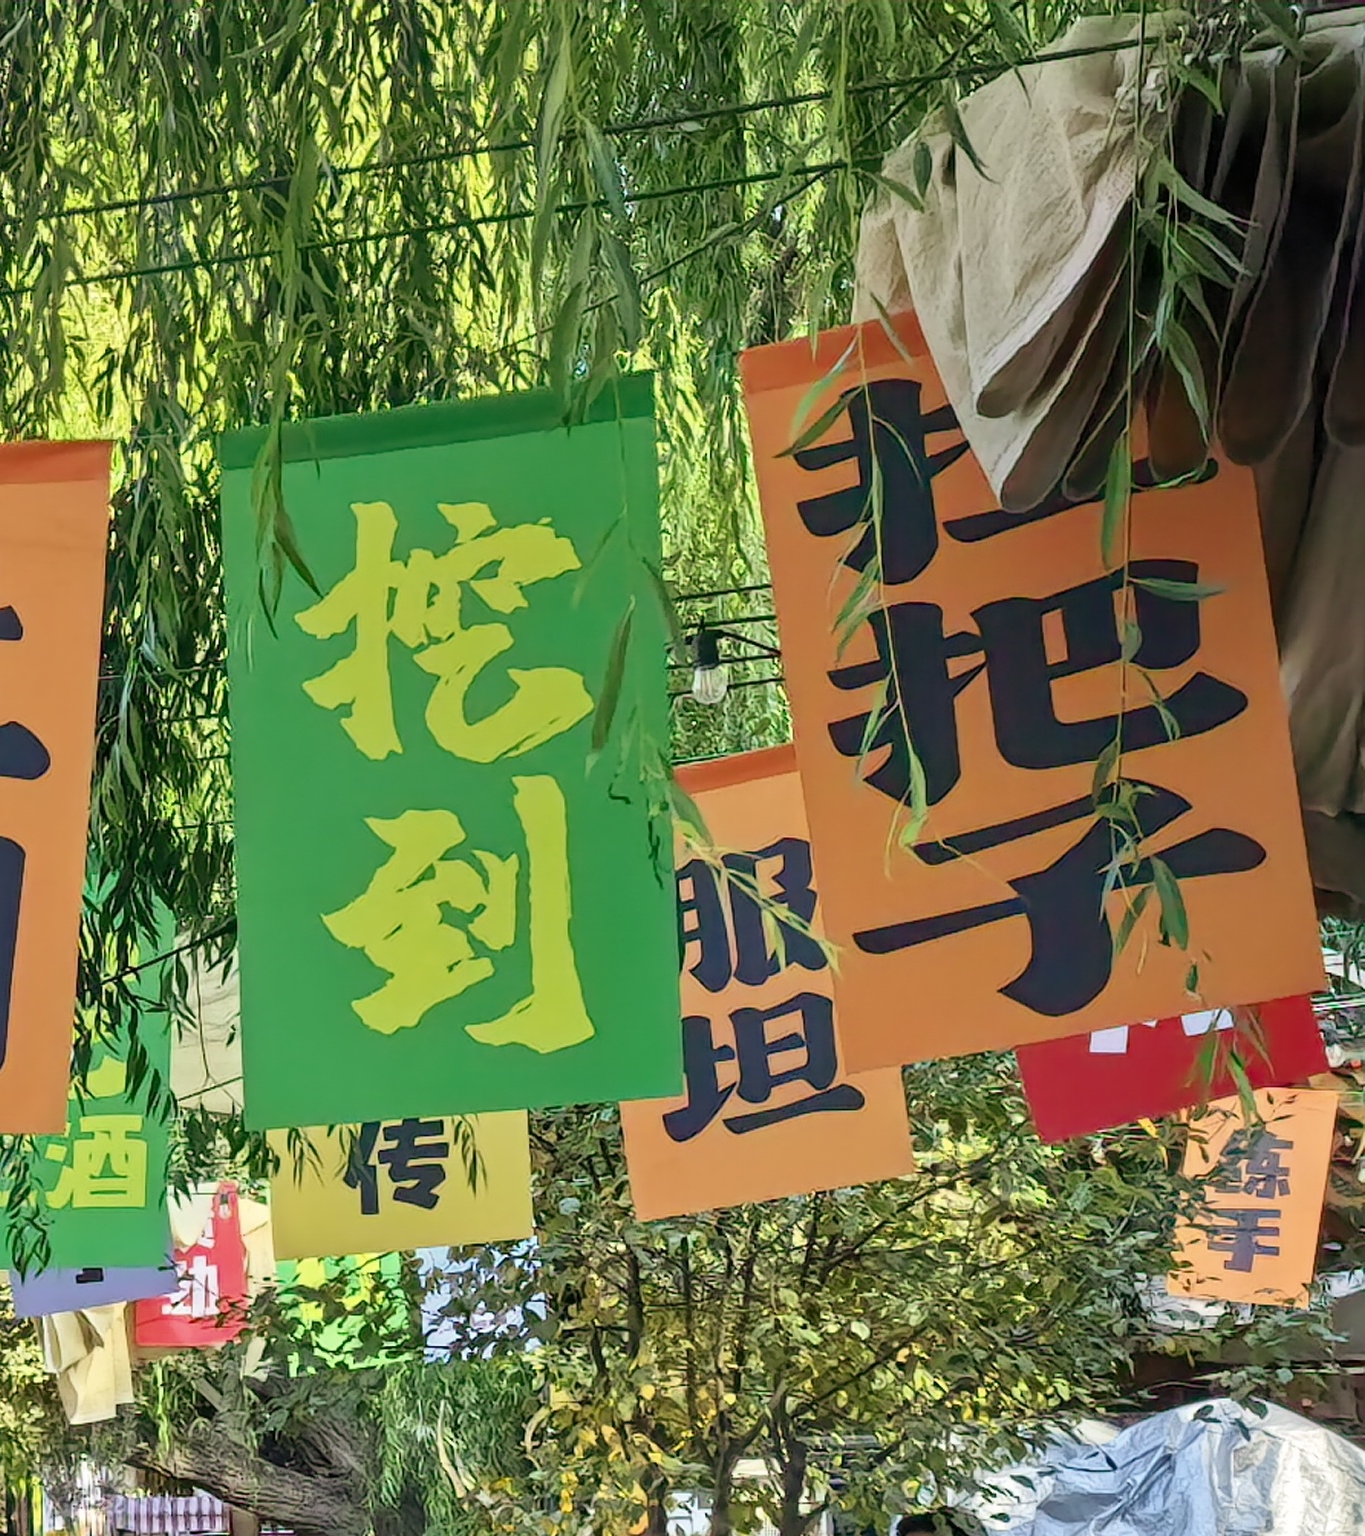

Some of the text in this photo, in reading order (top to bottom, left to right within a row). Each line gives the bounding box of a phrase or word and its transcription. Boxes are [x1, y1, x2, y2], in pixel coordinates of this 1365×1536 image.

[295, 500, 595, 1056] 挖到
[662, 836, 866, 1143] 服坦
[344, 1118, 450, 1215] 传
